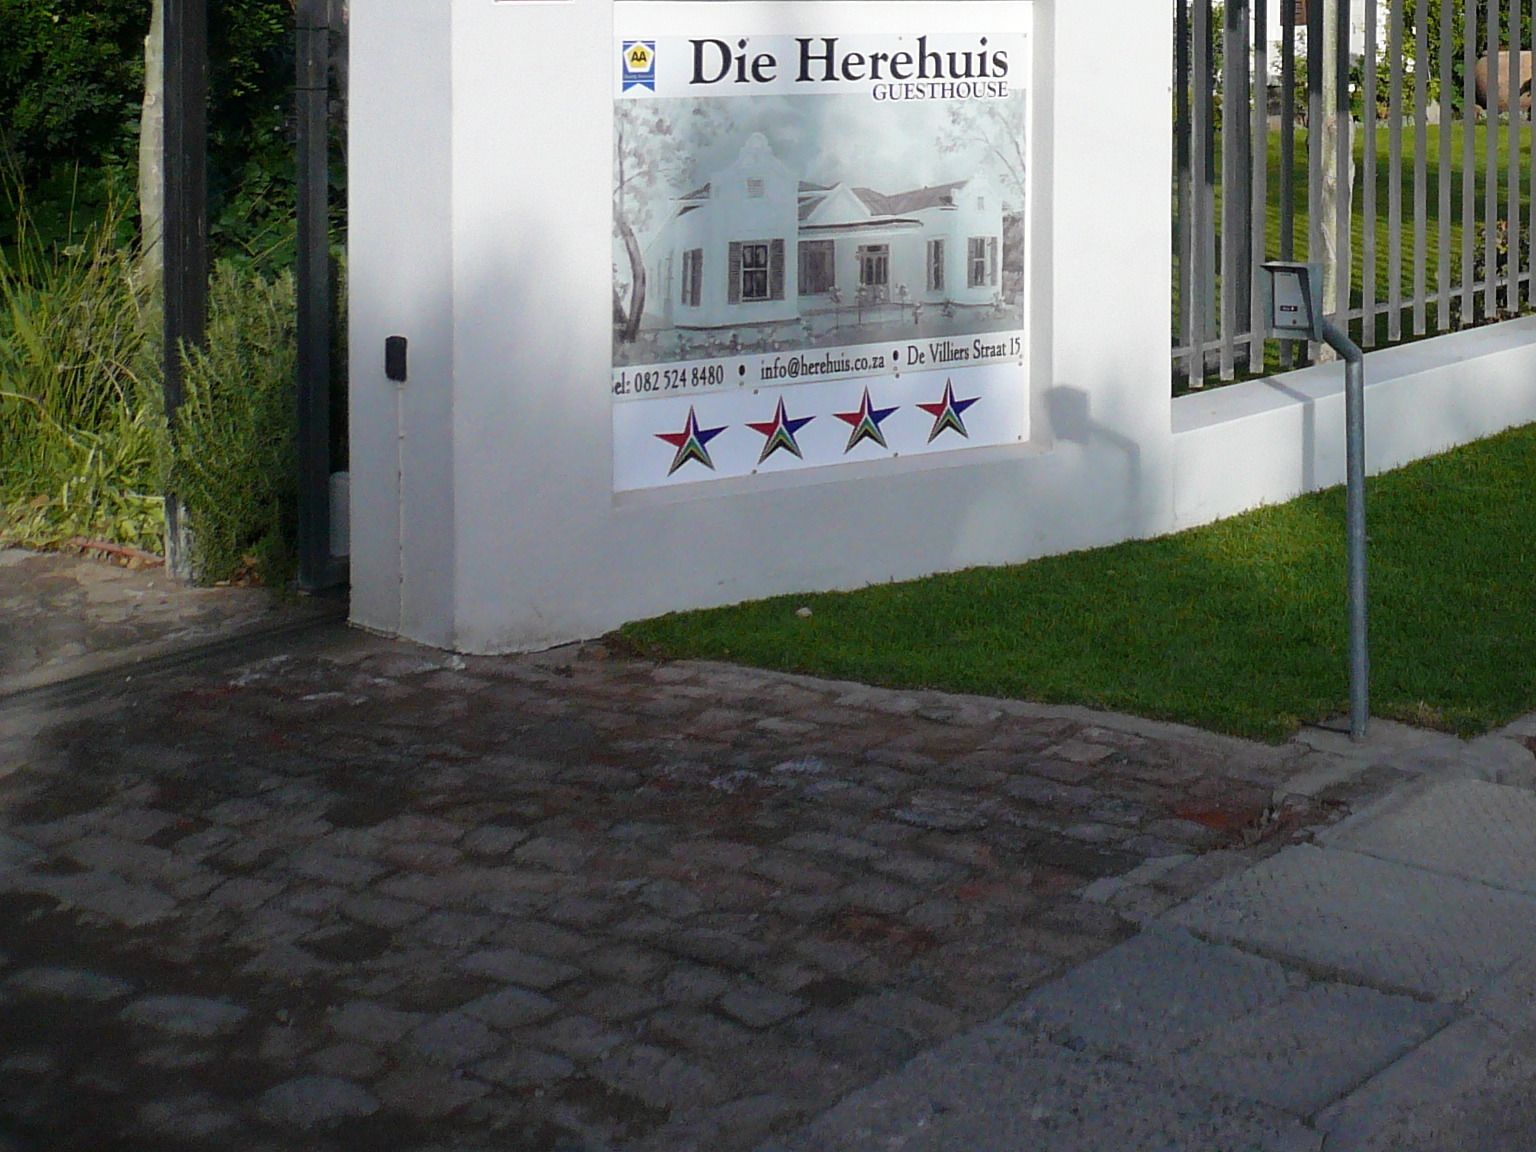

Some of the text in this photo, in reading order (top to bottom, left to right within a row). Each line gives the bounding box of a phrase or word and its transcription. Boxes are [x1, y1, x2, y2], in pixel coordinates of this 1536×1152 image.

[631, 51, 647, 62] AA
[688, 35, 1009, 85] Die Herehuis
[872, 81, 1009, 101] GUESTHOUSE
[612, 337, 1021, 395] el: 082 524 8480 info@herehuis.co.za De Villiers Straat 15
